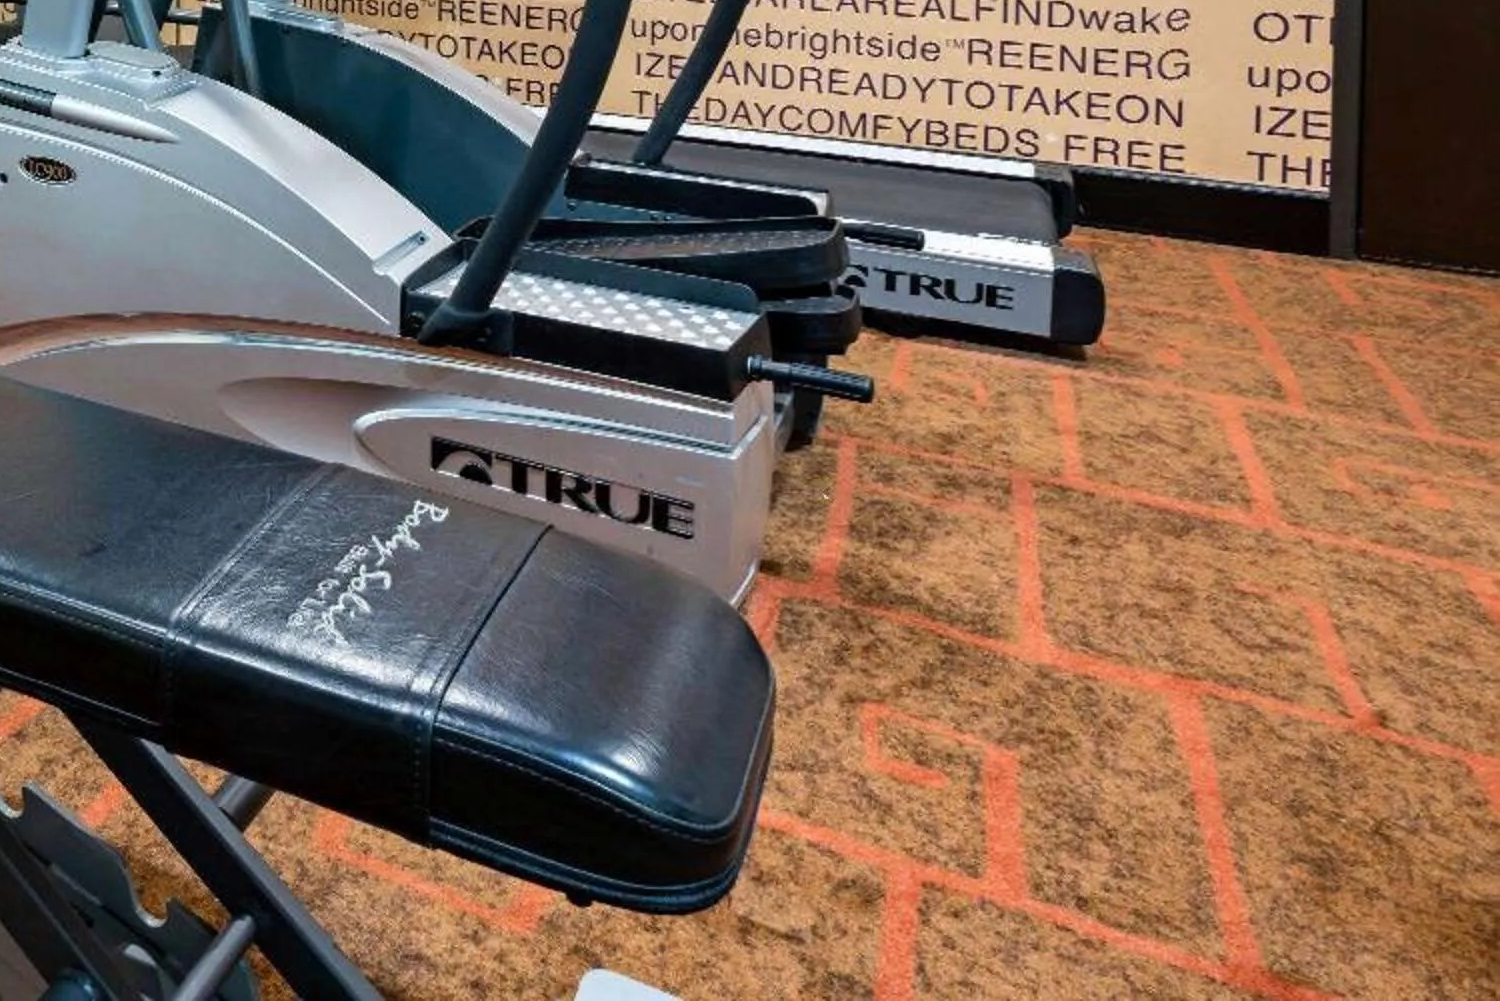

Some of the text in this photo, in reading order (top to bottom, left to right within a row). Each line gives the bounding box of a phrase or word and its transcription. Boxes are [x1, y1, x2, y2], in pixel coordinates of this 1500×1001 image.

[1063, 133, 1187, 175] FREE
[873, 266, 1016, 310] TRUE
[496, 452, 695, 539] TRUE
